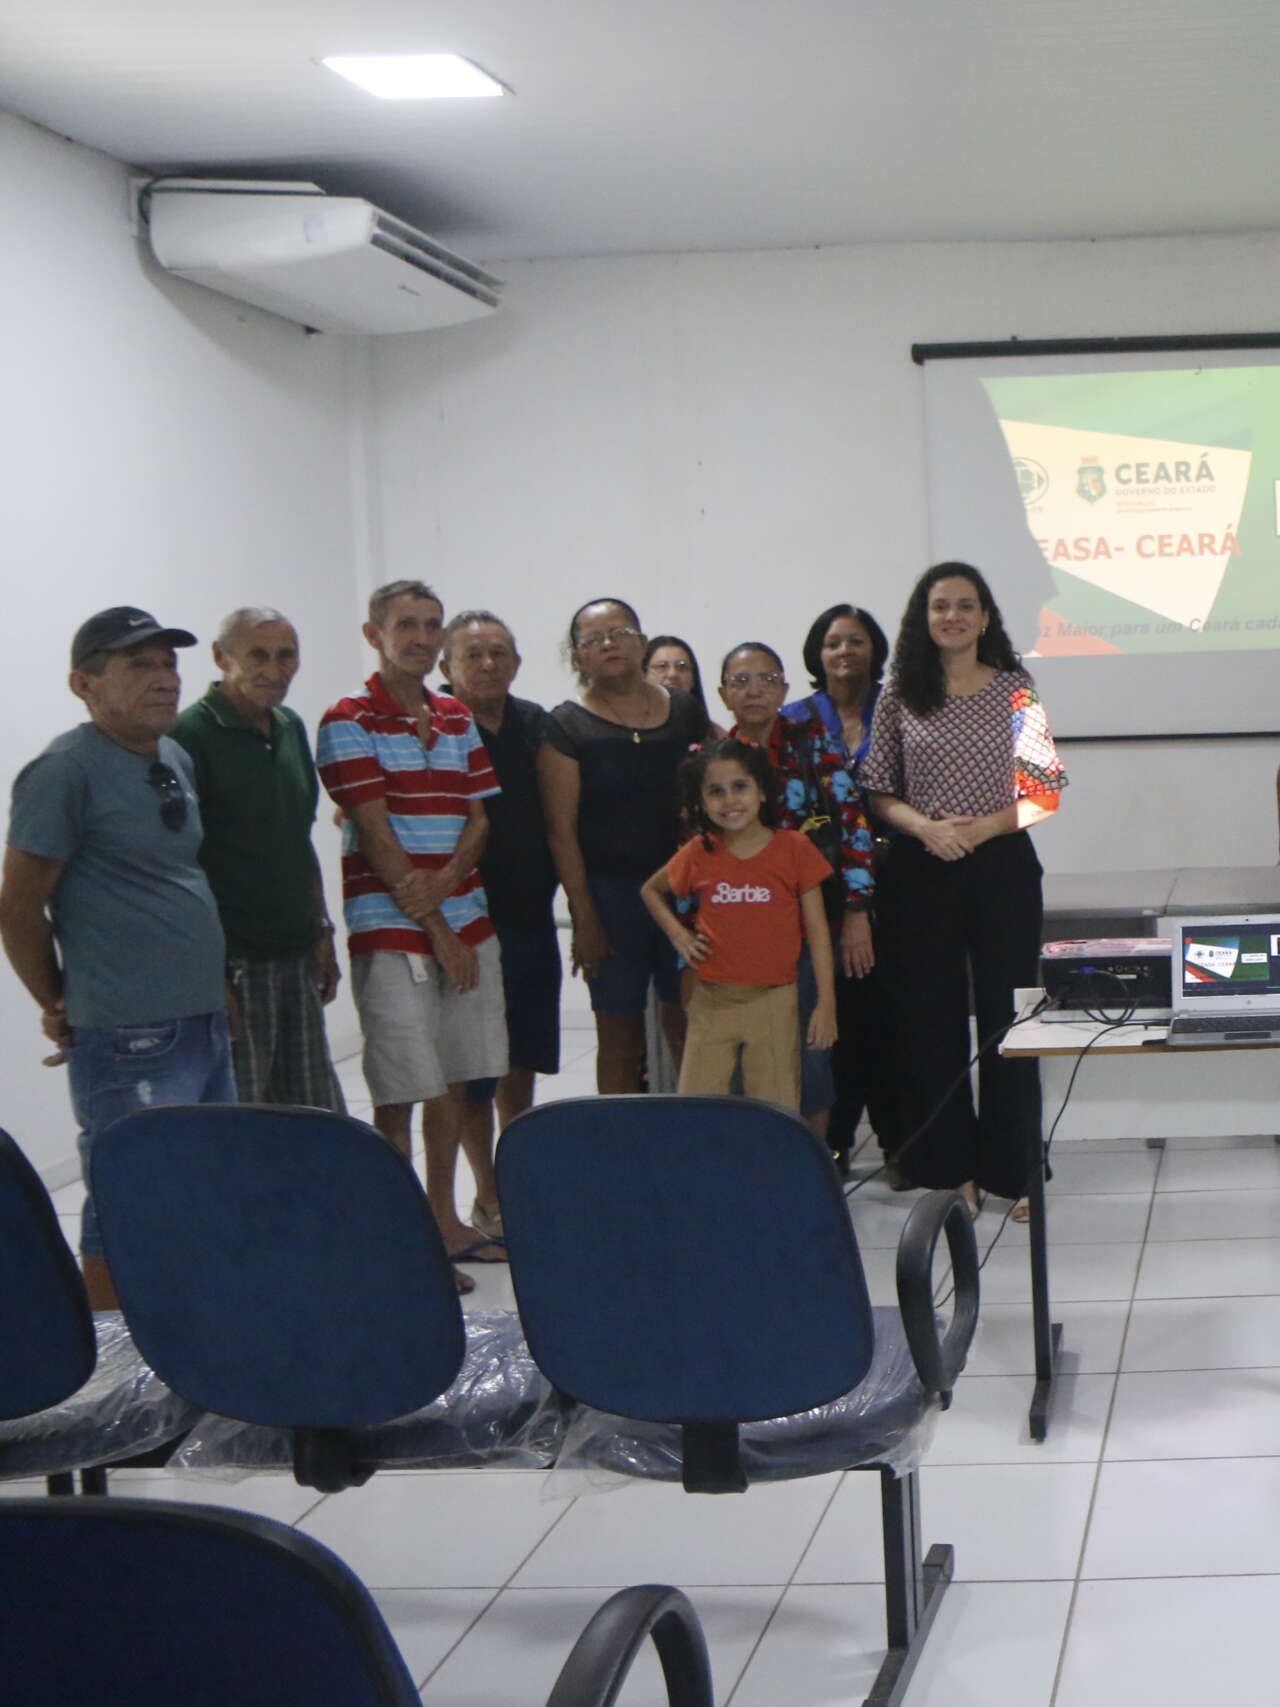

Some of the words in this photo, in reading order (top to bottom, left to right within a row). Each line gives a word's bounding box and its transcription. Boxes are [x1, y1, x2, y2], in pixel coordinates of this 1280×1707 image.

[1115, 451, 1215, 485] CEARÁ
[1136, 523, 1242, 558] CEARÁ
[711, 882, 770, 903] Barbie
